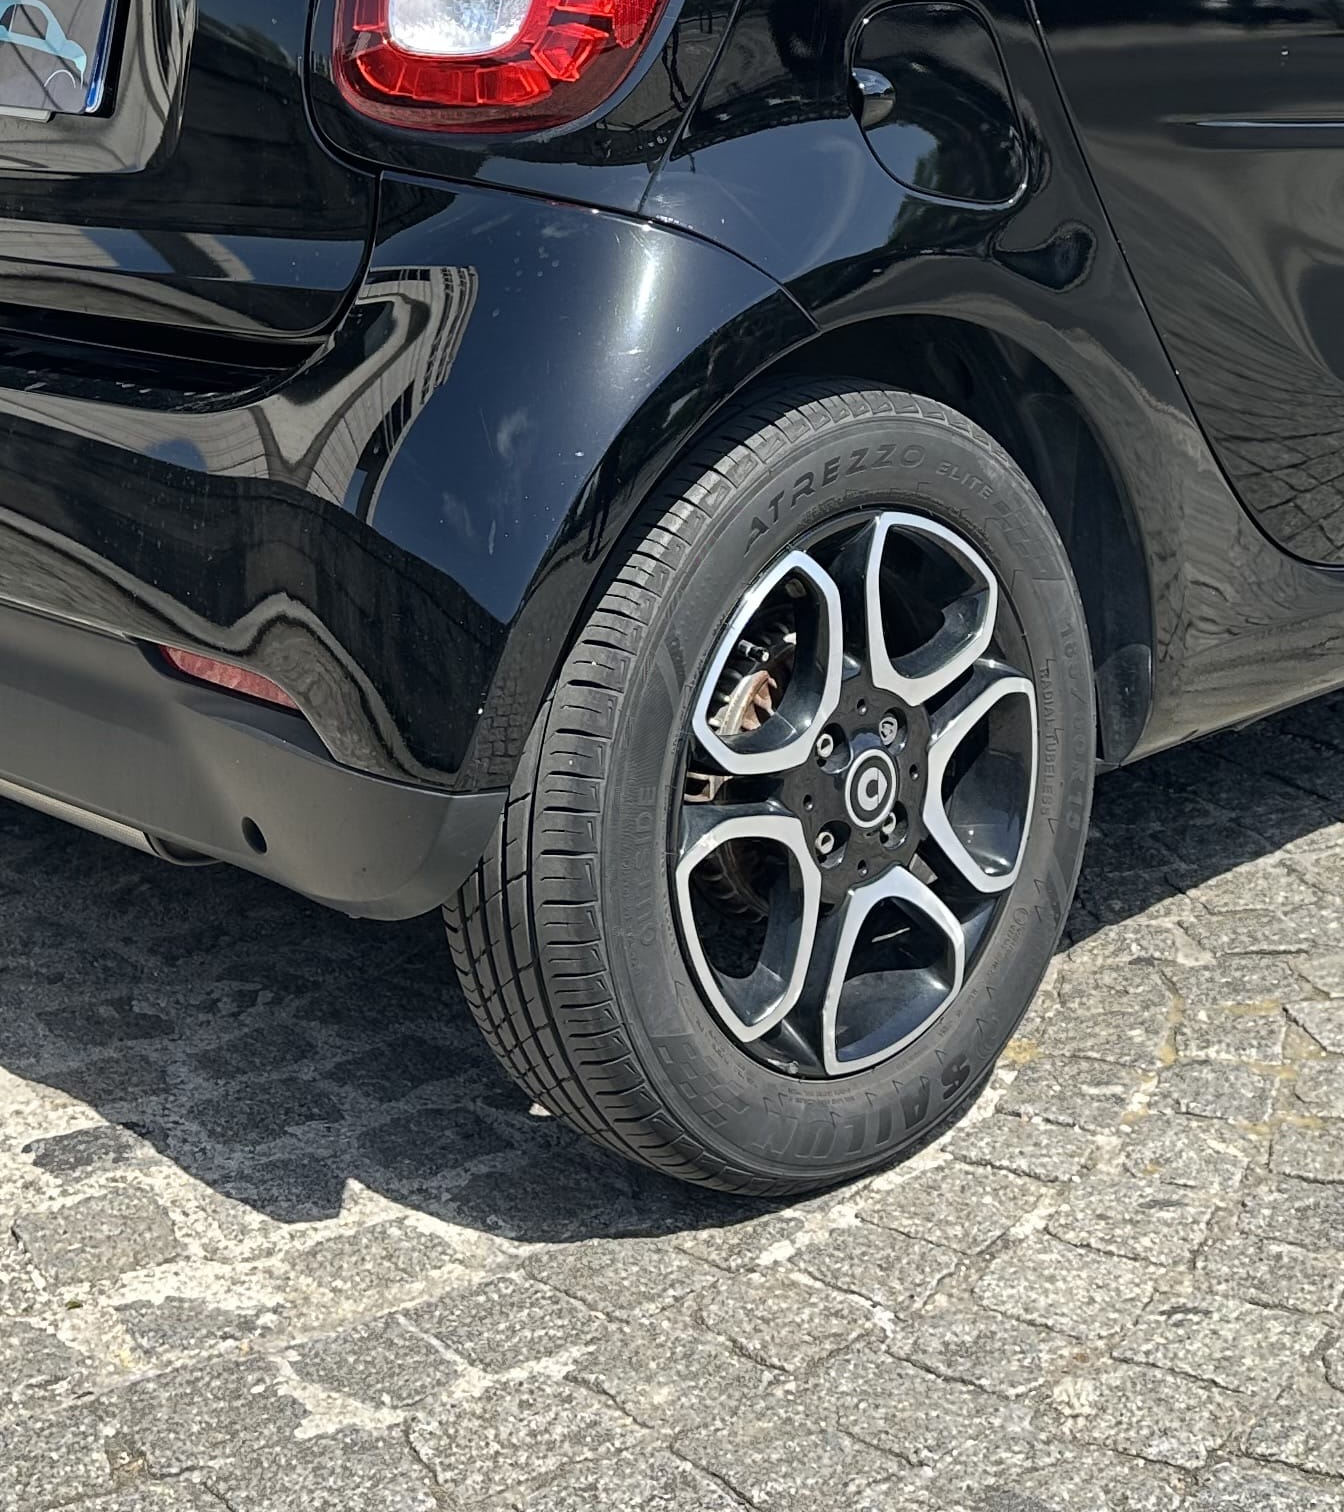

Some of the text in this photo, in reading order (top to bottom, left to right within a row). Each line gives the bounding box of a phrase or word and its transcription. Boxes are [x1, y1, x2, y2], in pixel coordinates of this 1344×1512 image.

[743, 443, 995, 560] ATREZZO ELITE
[1039, 666, 1059, 728] RADIAL
[753, 1054, 972, 1160] SAILUN
